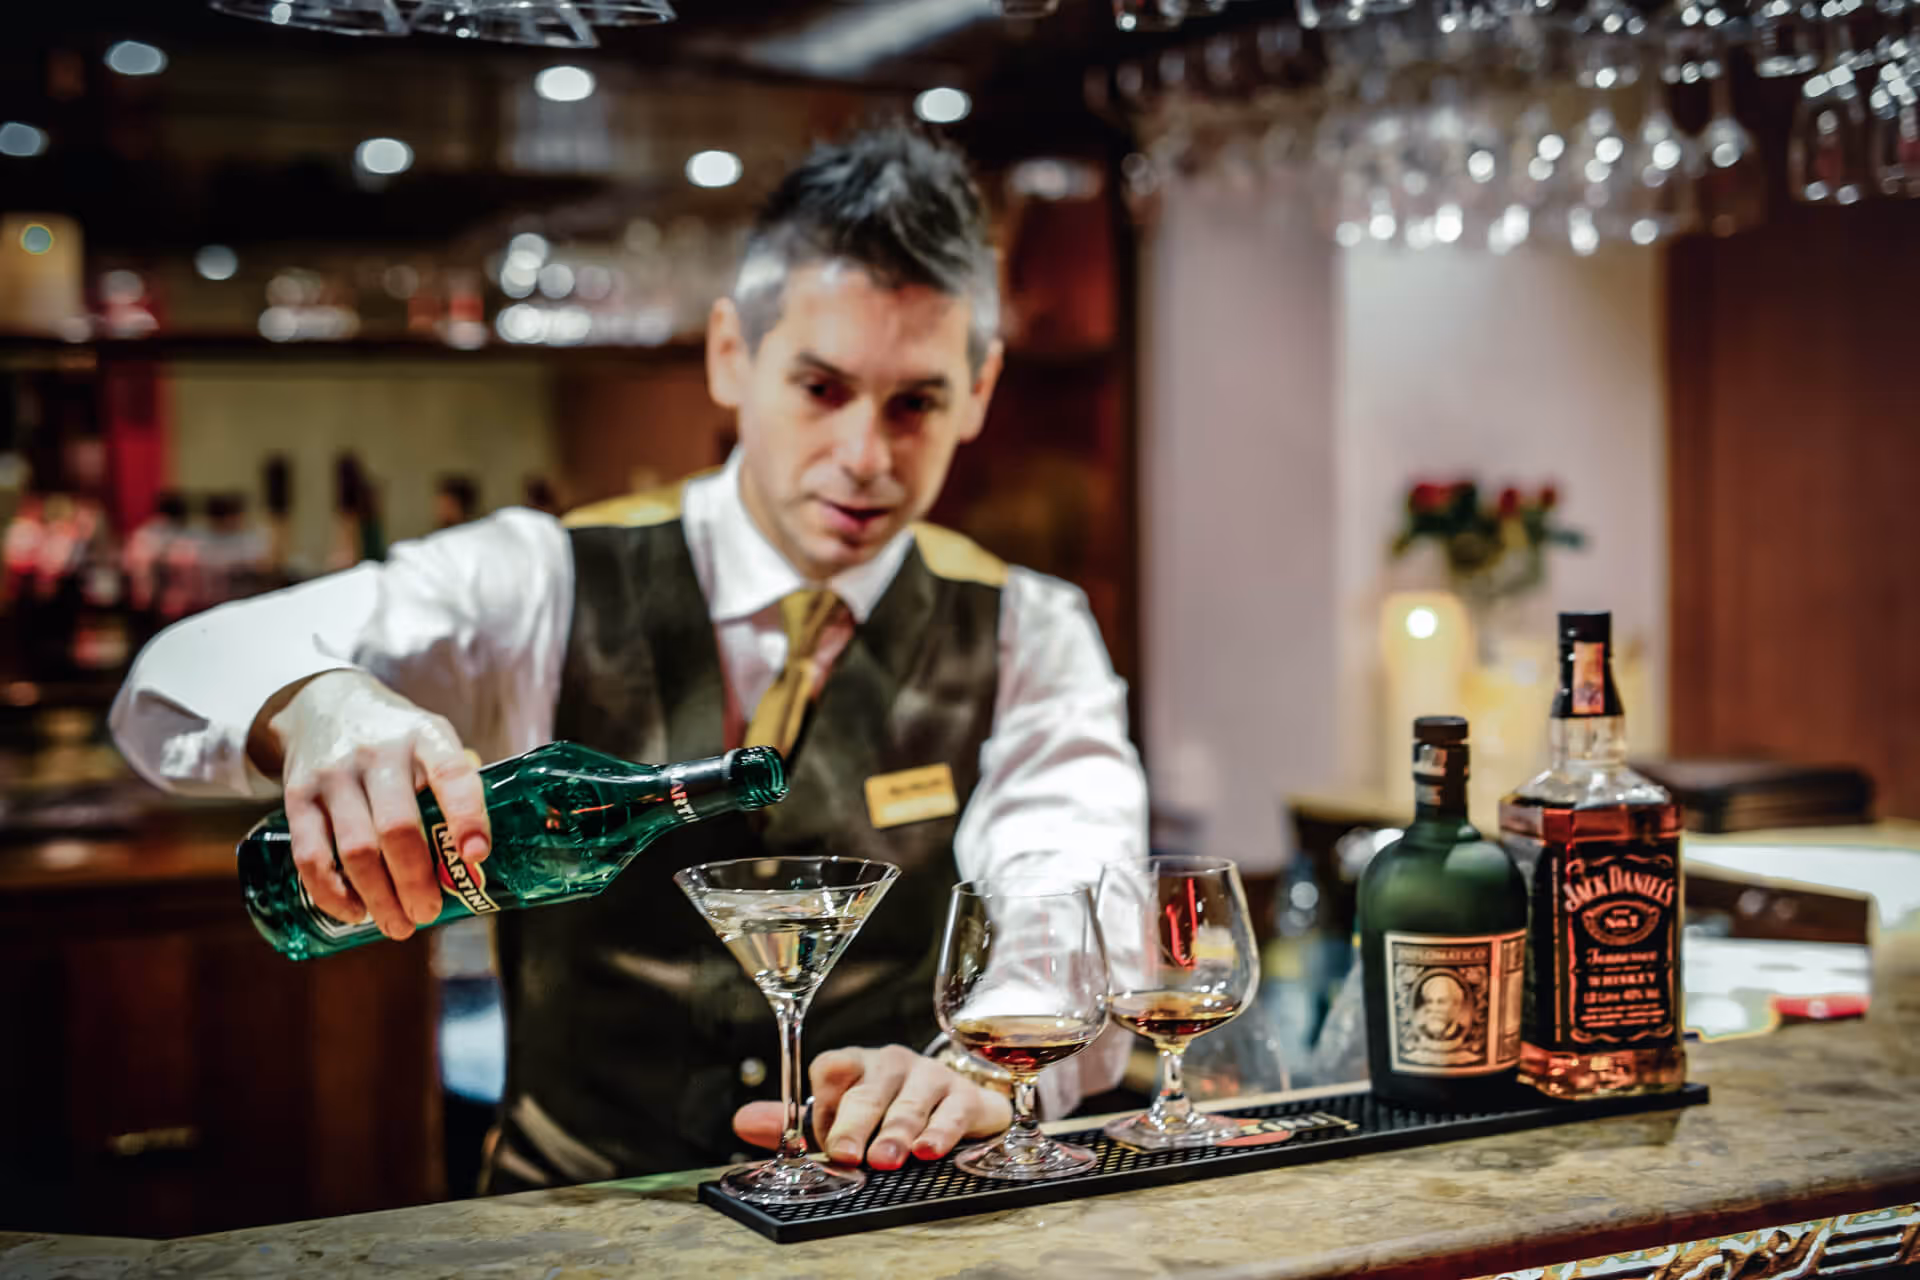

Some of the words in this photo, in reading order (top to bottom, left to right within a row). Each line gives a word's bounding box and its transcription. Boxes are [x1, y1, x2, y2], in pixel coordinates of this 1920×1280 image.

[438, 831, 490, 911] MARTINI
[1563, 873, 1608, 912] JACK
[1587, 972, 1656, 987] WHISKEY
